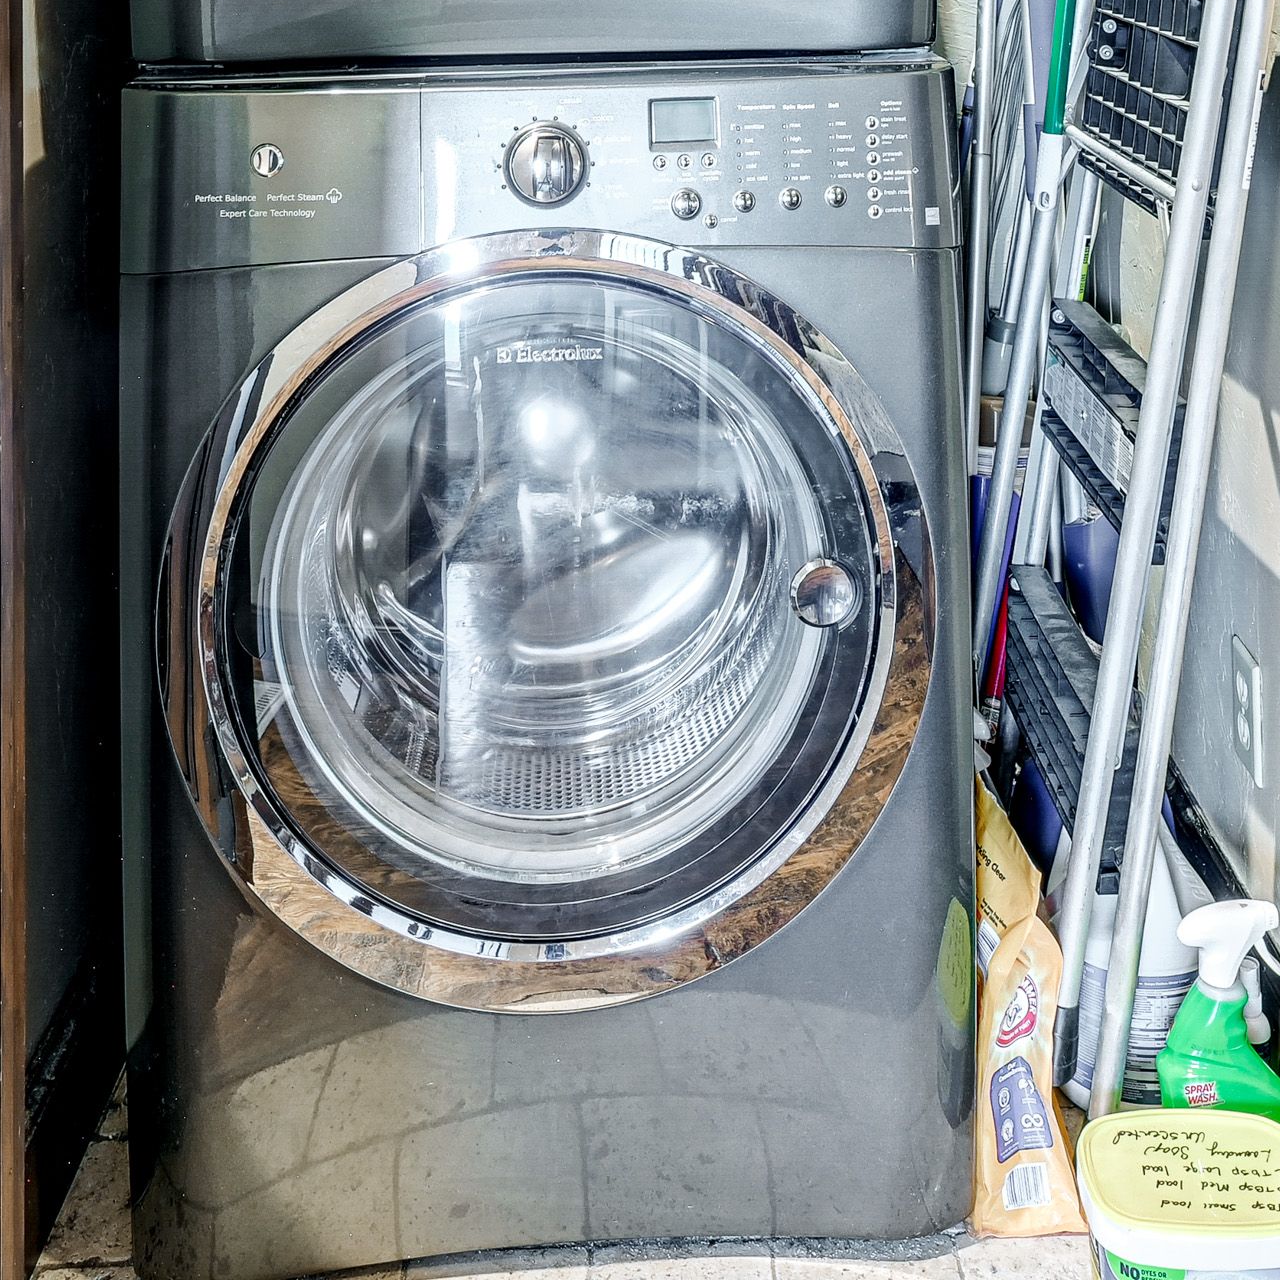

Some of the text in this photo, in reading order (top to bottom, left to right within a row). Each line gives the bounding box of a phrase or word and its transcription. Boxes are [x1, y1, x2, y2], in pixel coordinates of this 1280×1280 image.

[789, 136, 802, 144] high
[194, 194, 257, 203] Perfect Balance
[266, 194, 325, 202] Perfect Steam
[220, 208, 316, 220] Expert Care Technology
[516, 344, 603, 363] Electrolux
[991, 861, 1007, 882] Clear
[1184, 1082, 1215, 1095] SPRAY
[1188, 1093, 1216, 1104] WASH
[1144, 1146, 1190, 1160] Soap
[1142, 1164, 1170, 1176] load
[1156, 1179, 1184, 1190] load
[1202, 1182, 1230, 1192] Med
[1160, 1199, 1192, 1208] load
[1204, 1202, 1236, 1210] Small
[1120, 1261, 1140, 1280] NO
[1141, 1270, 1156, 1278] DYES
